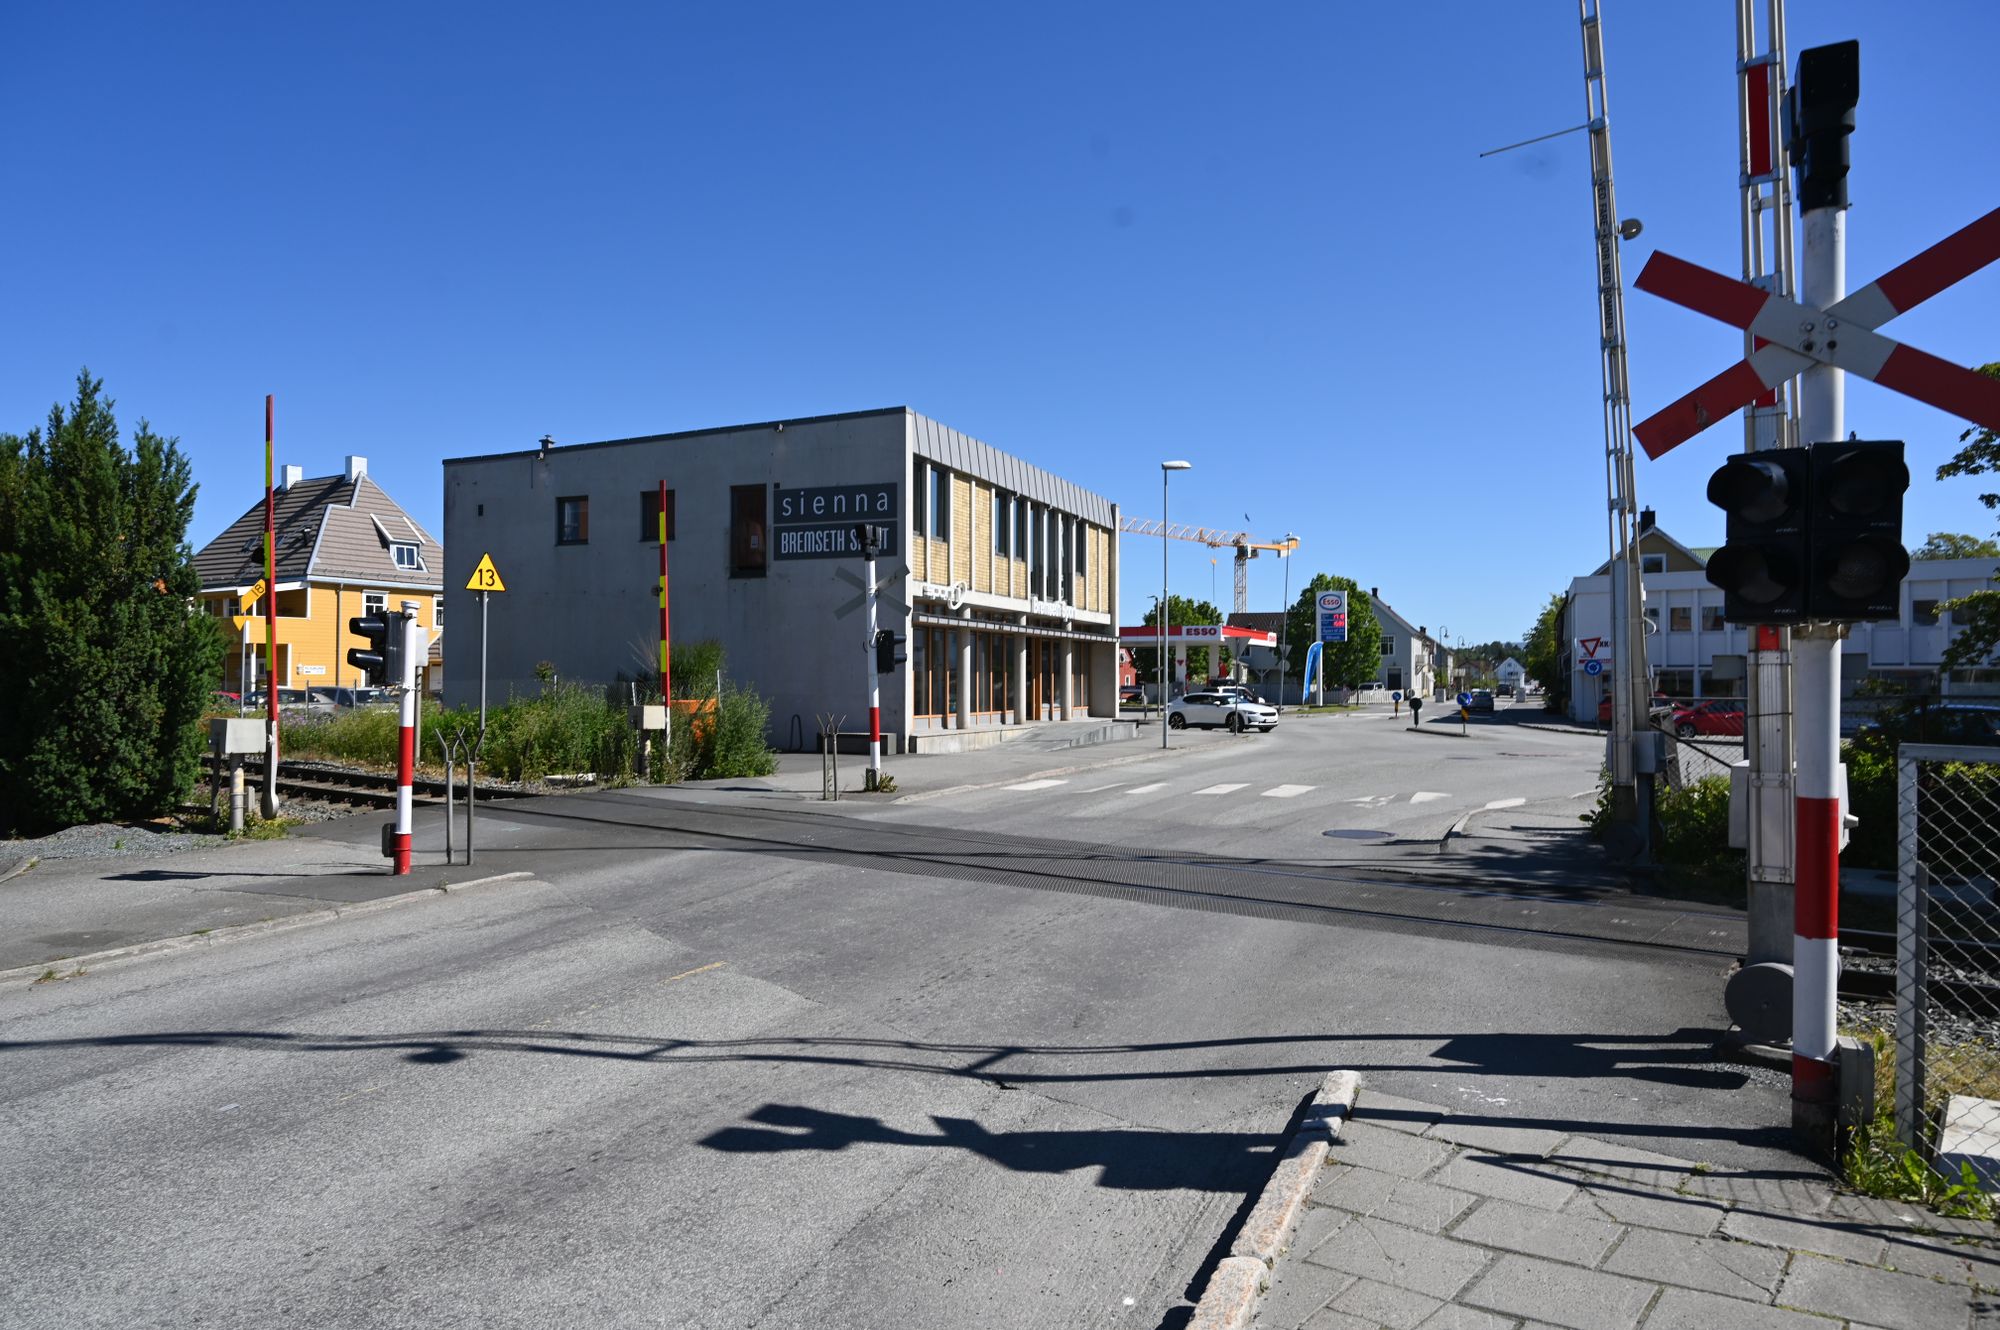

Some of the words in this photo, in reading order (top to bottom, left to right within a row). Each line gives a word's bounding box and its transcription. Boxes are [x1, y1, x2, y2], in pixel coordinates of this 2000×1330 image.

[1602, 263, 1612, 283] NED
[782, 491, 888, 517] sienna
[781, 529, 845, 554] BREMSETH
[478, 568, 495, 587] 13
[251, 584, 264, 597] 18
[1186, 627, 1217, 637] ESSO
